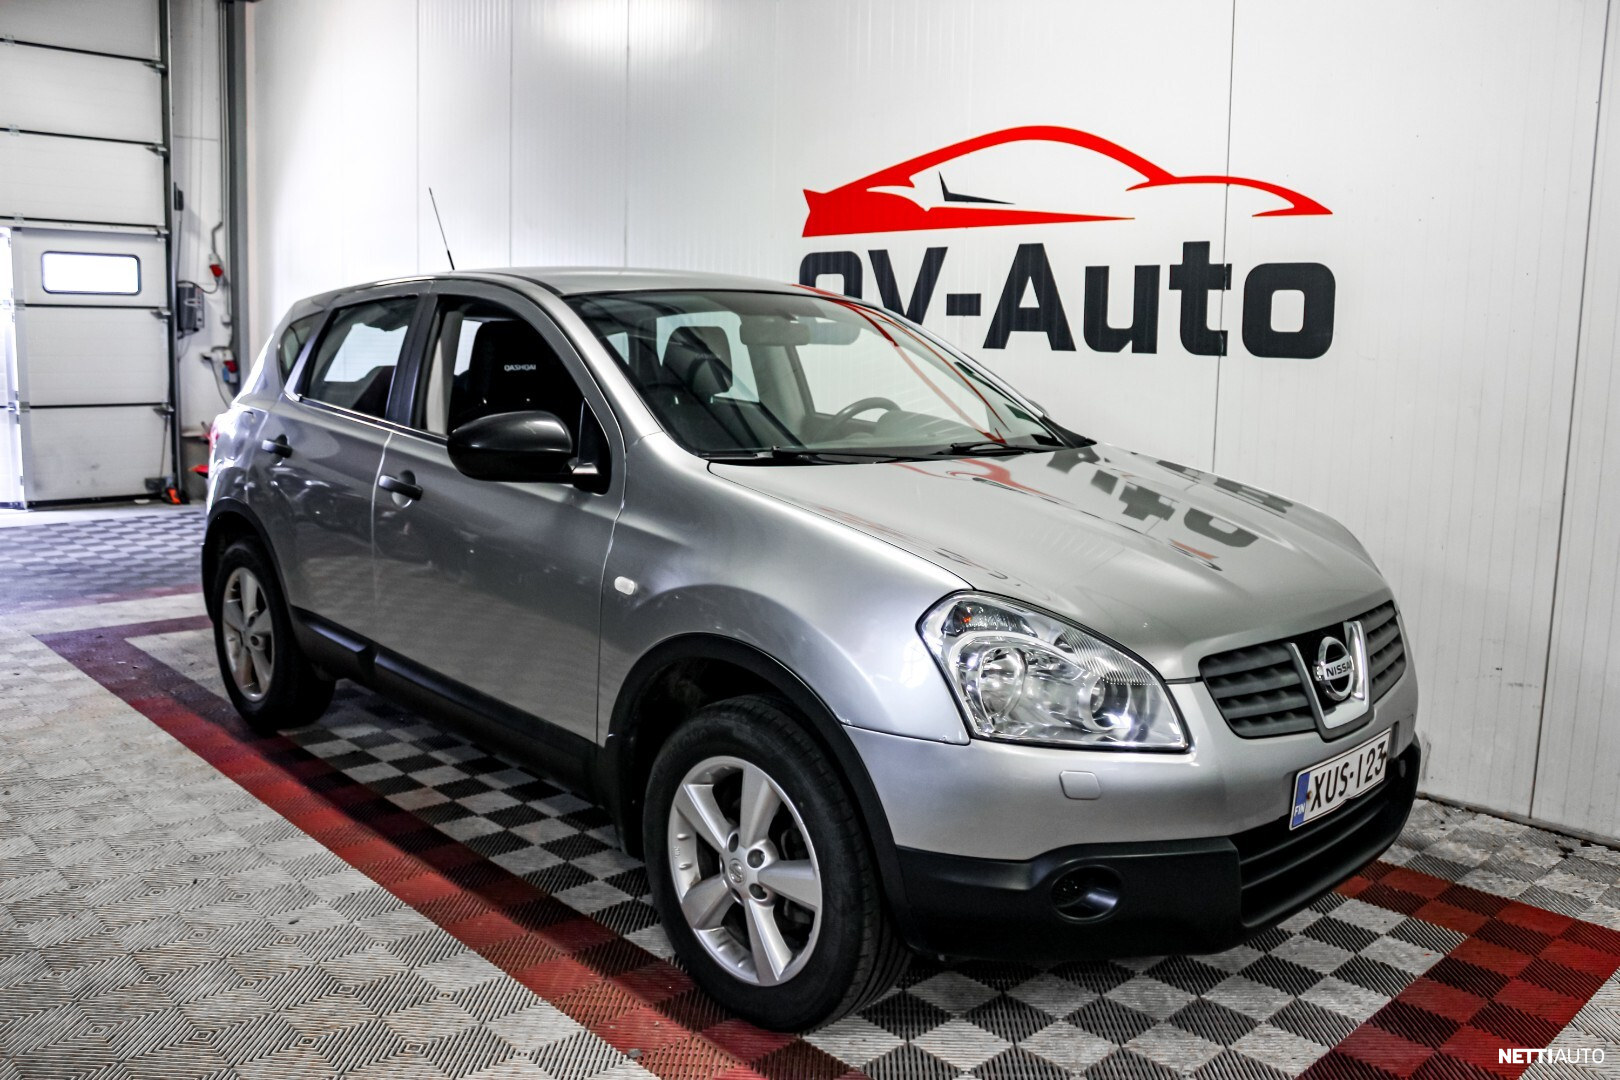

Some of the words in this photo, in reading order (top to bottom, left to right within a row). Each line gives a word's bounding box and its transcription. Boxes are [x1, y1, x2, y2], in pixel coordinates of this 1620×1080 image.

[504, 364, 537, 372] QASHQAI
[1310, 741, 1387, 812] XUS-123
[1294, 803, 1306, 816] FIN
